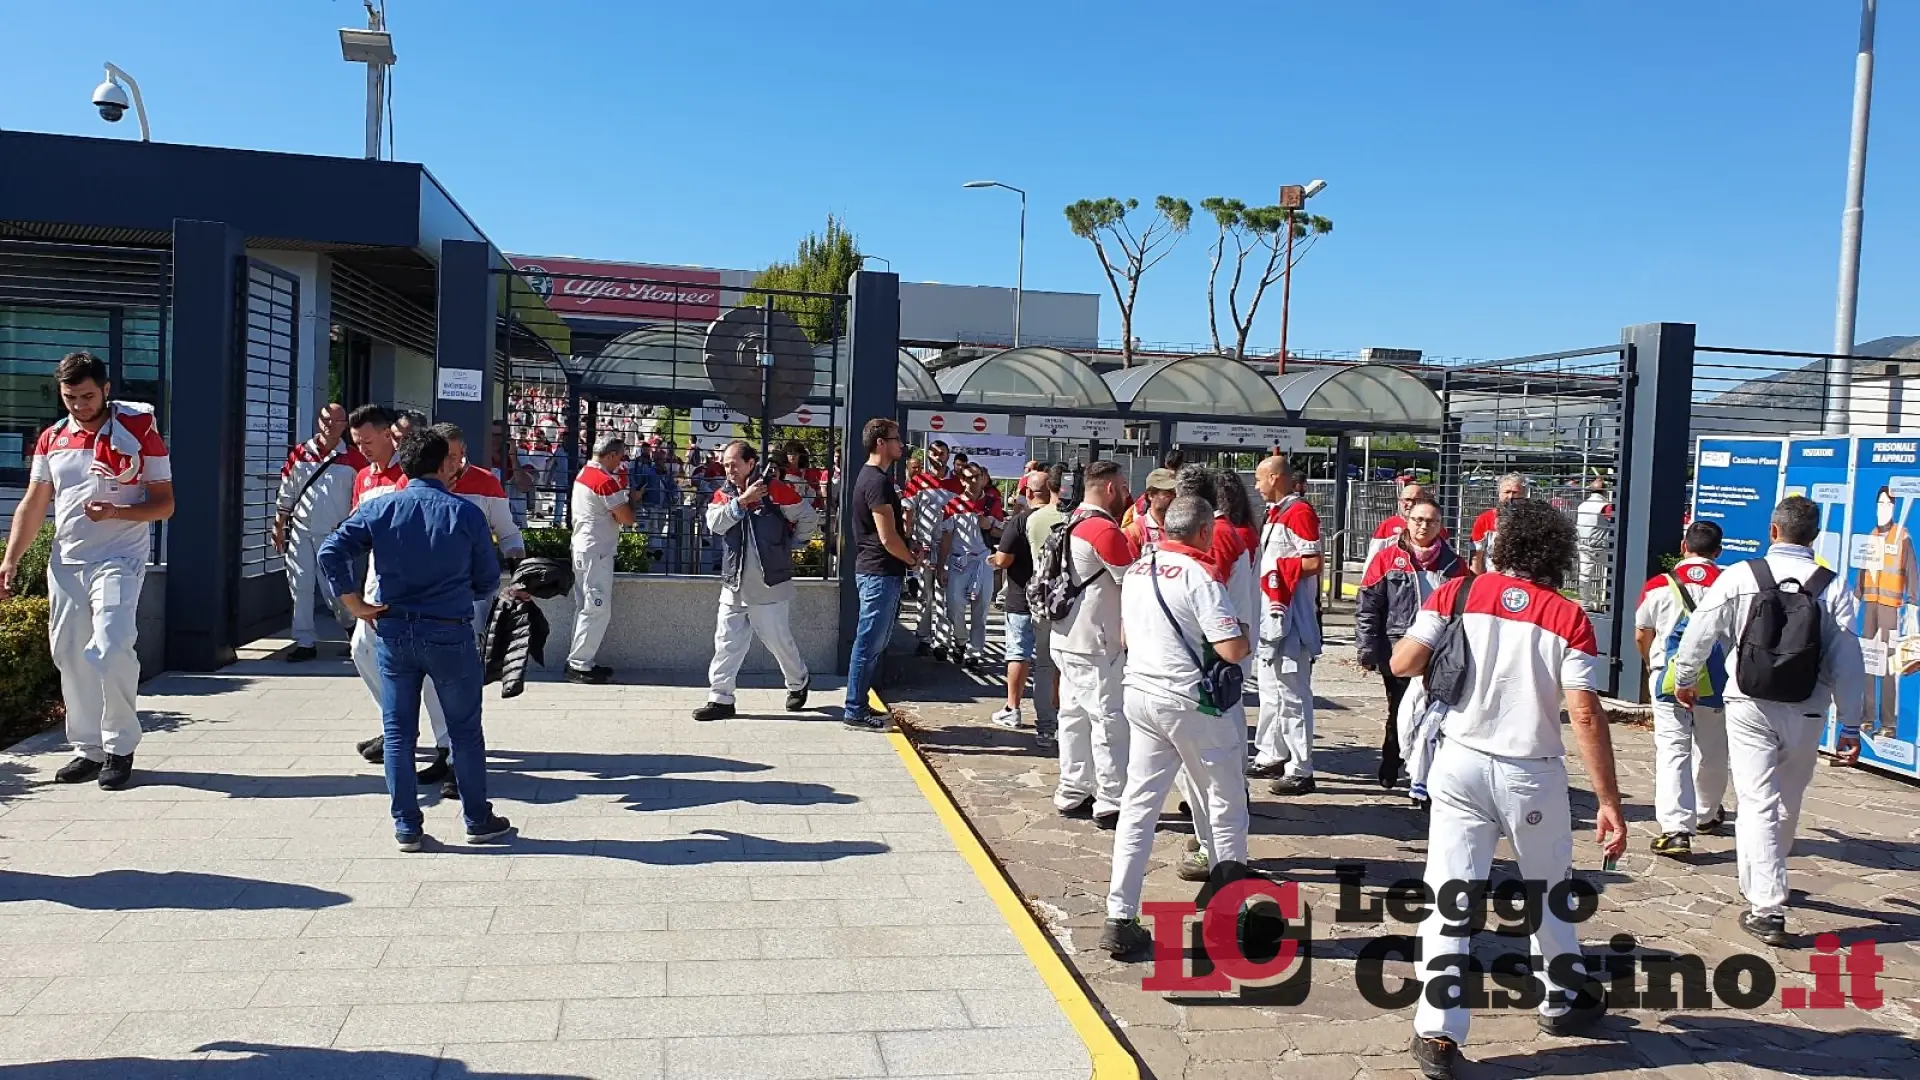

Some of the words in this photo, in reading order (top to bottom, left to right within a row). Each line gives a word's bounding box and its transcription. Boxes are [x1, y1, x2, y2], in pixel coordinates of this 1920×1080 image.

[563, 278, 624, 305] Alfa
[624, 283, 715, 304] Romeo
[1873, 442, 1917, 452] PERSONALE
[1759, 457, 1779, 466] Plant
